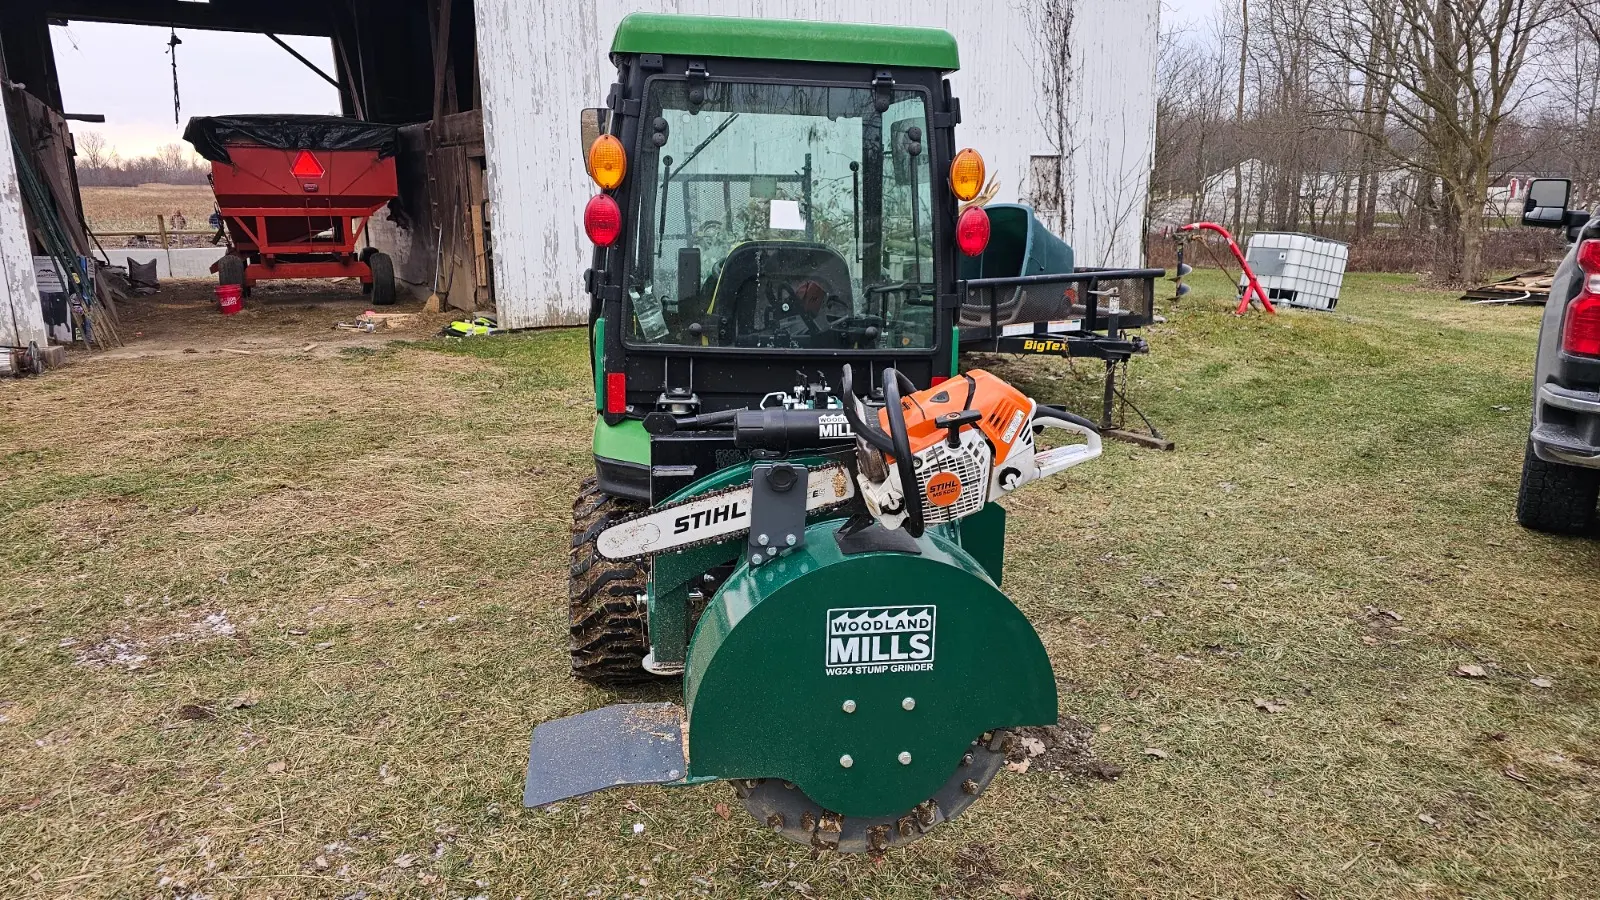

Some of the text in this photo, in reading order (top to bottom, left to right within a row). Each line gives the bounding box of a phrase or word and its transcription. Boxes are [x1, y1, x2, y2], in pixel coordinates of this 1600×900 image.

[1024, 340, 1067, 352] BigTex
[819, 424, 855, 437] MILL
[930, 481, 958, 493] STIHL
[673, 502, 746, 535] STIHL
[834, 618, 929, 632] WOODLAND
[830, 633, 931, 663] MILLS
[825, 663, 934, 676] WG24 STUMP GRINDER
